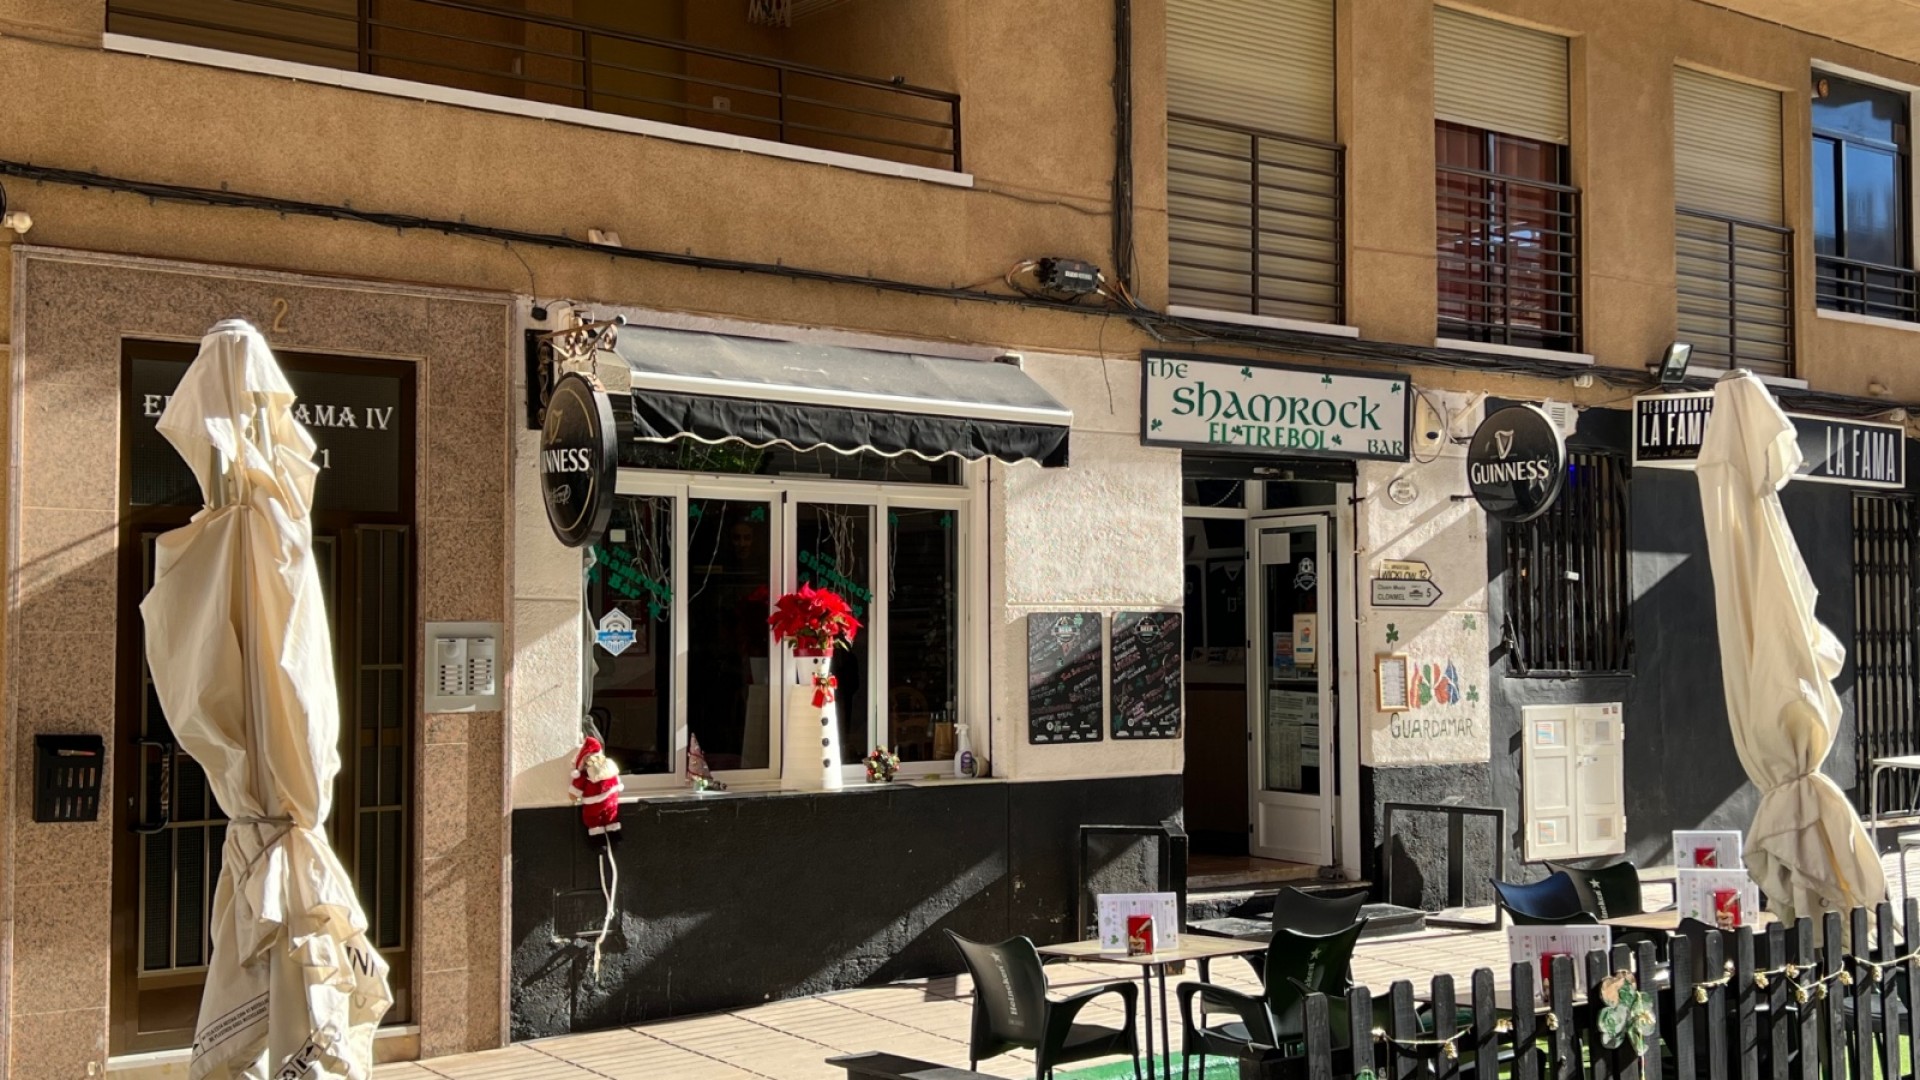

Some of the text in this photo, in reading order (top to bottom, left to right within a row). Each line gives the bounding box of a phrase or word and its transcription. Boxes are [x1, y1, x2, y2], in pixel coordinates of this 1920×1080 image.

[273, 298, 288, 333] 2
[294, 404, 358, 429] AMA
[366, 406, 394, 430] IV
[1642, 398, 1711, 414] RESTAURANTE
[1208, 421, 1330, 451] EL TREBOL
[1642, 413, 1660, 447] LA
[1367, 438, 1405, 456] BAR
[1826, 425, 1896, 482] LA FAMA
[1471, 459, 1549, 485] GUINNESS
[1426, 587, 1432, 598] 5
[1390, 712, 1477, 741] GUARDAMAR
